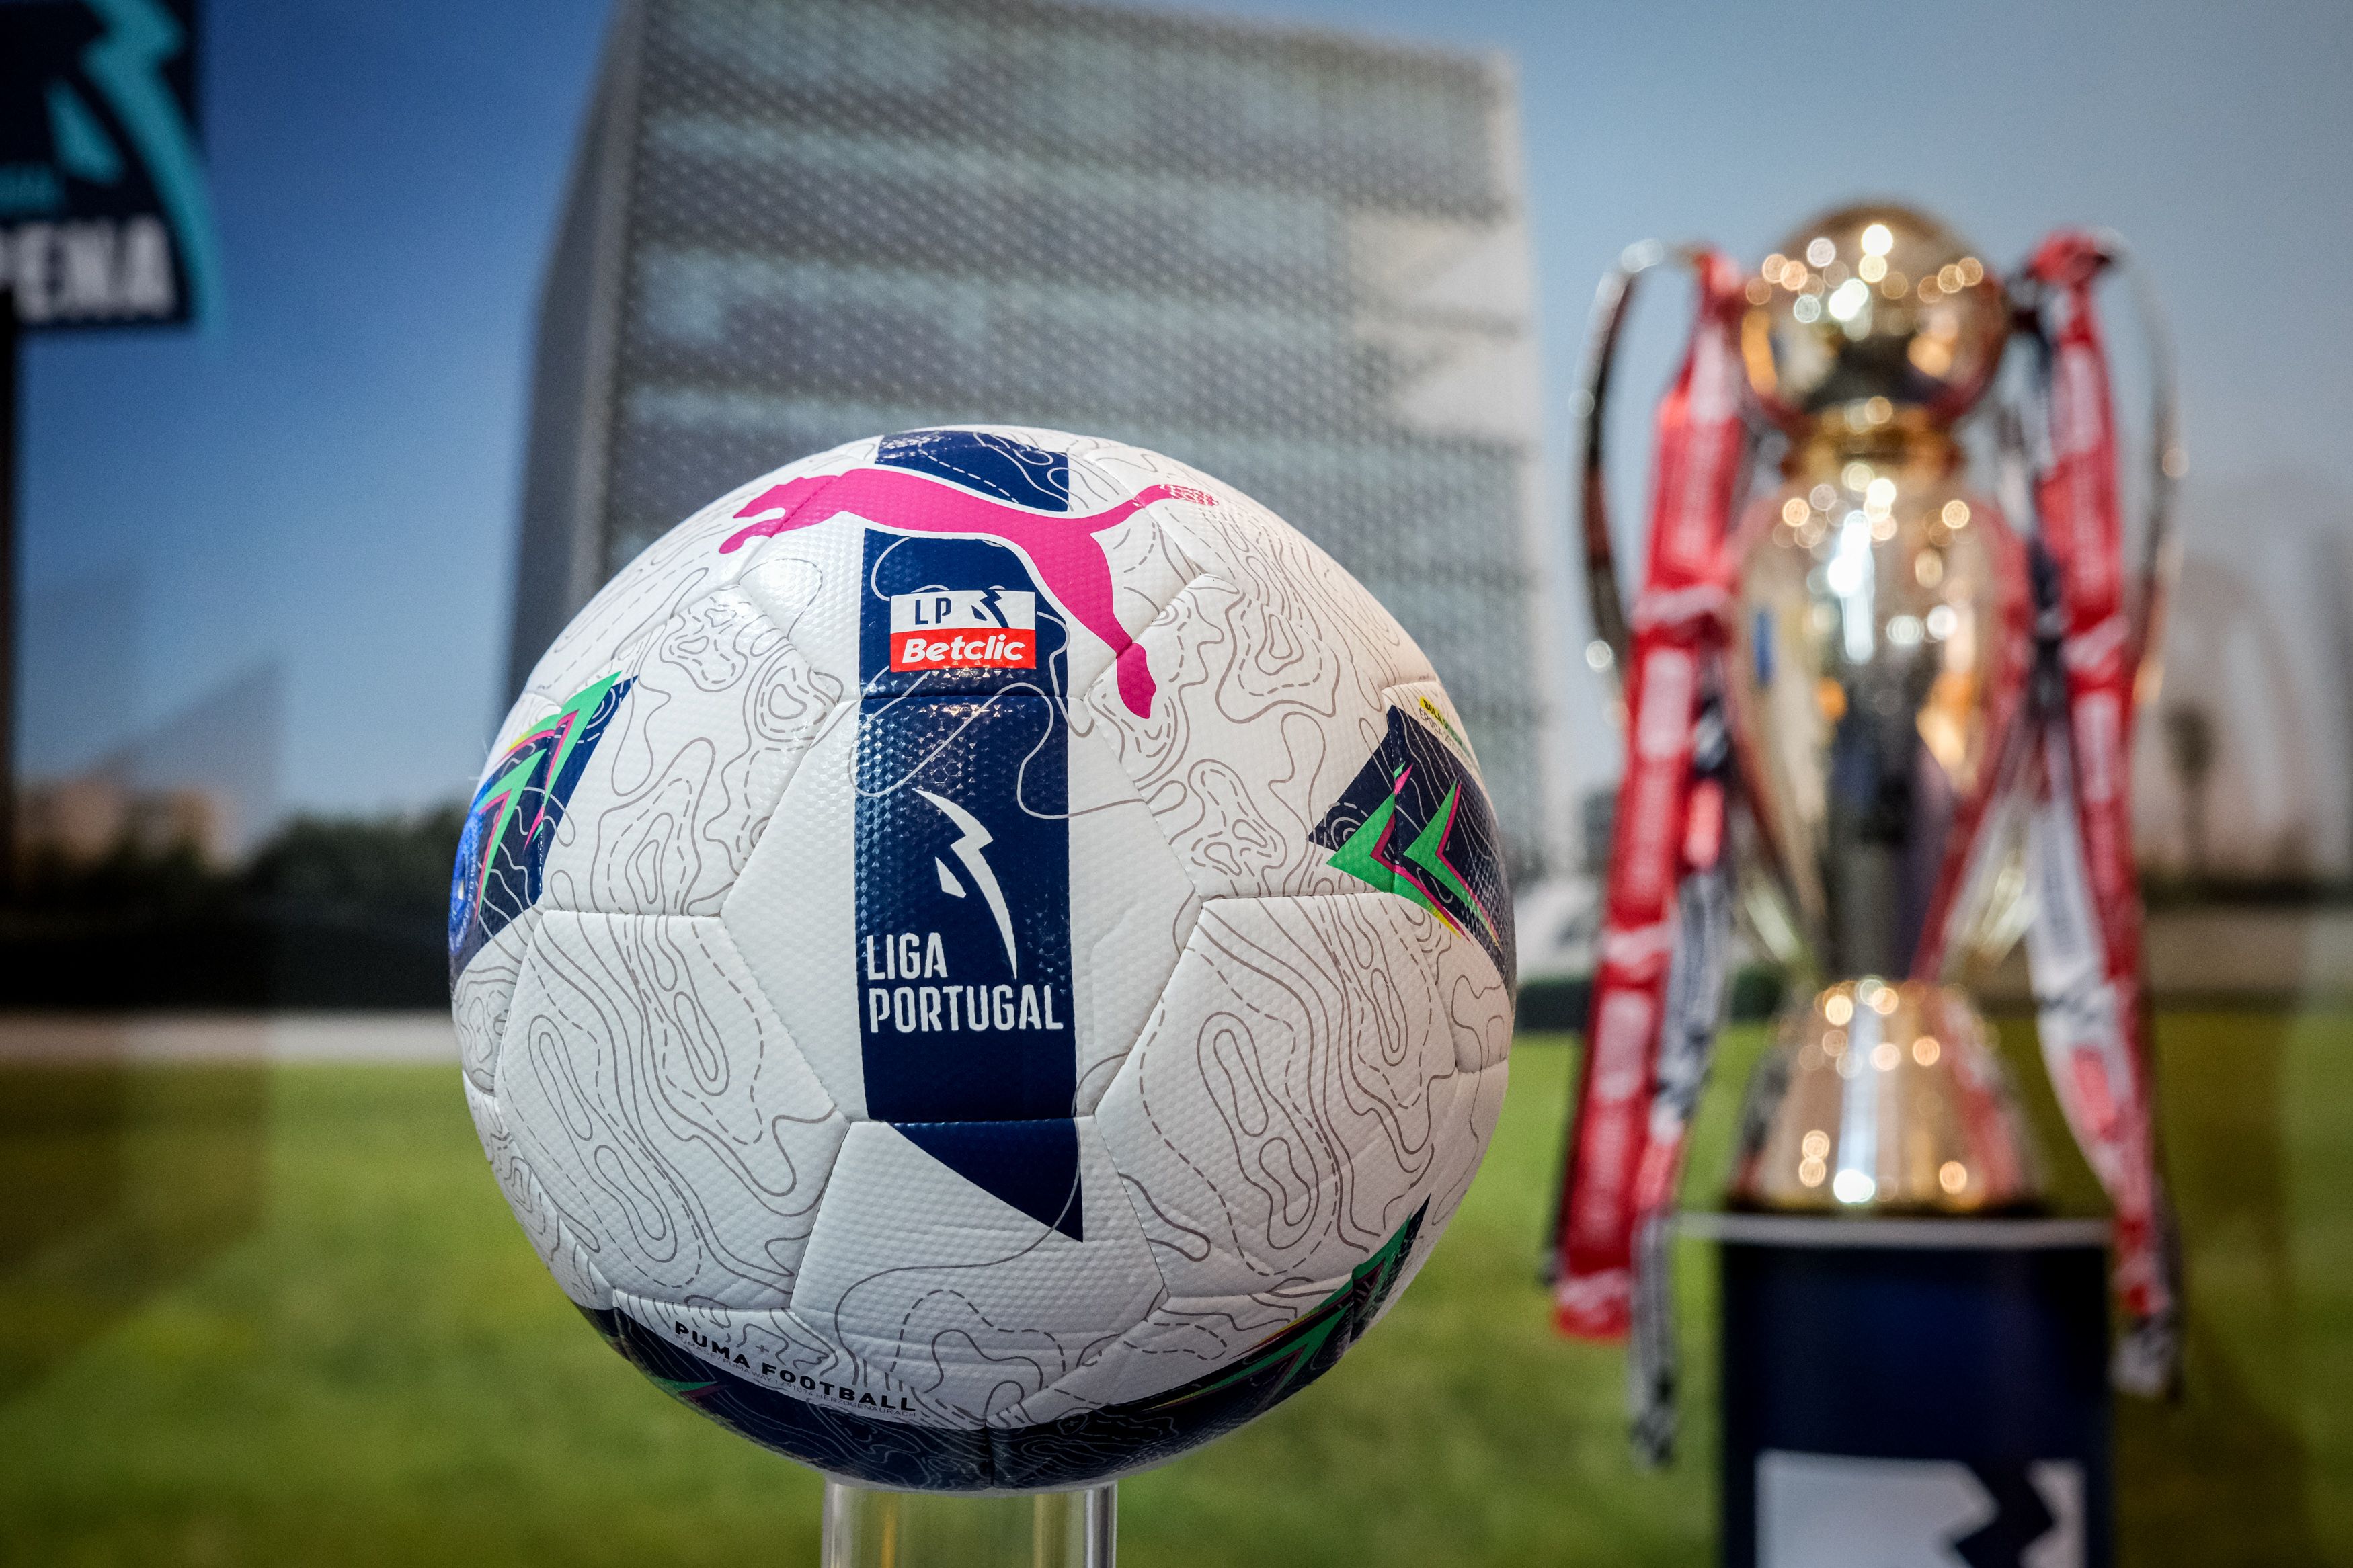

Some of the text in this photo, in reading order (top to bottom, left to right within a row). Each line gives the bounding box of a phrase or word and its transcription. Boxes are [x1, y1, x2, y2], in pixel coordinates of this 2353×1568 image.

[915, 597, 951, 625] LP
[902, 634, 1025, 663] Betclic
[867, 932, 948, 980] LIGA
[869, 984, 1064, 1033] PORTUGAL
[675, 1321, 916, 1412] PUMA FOOTBALL
[816, 1393, 916, 1417] HERZOGENAURACH
